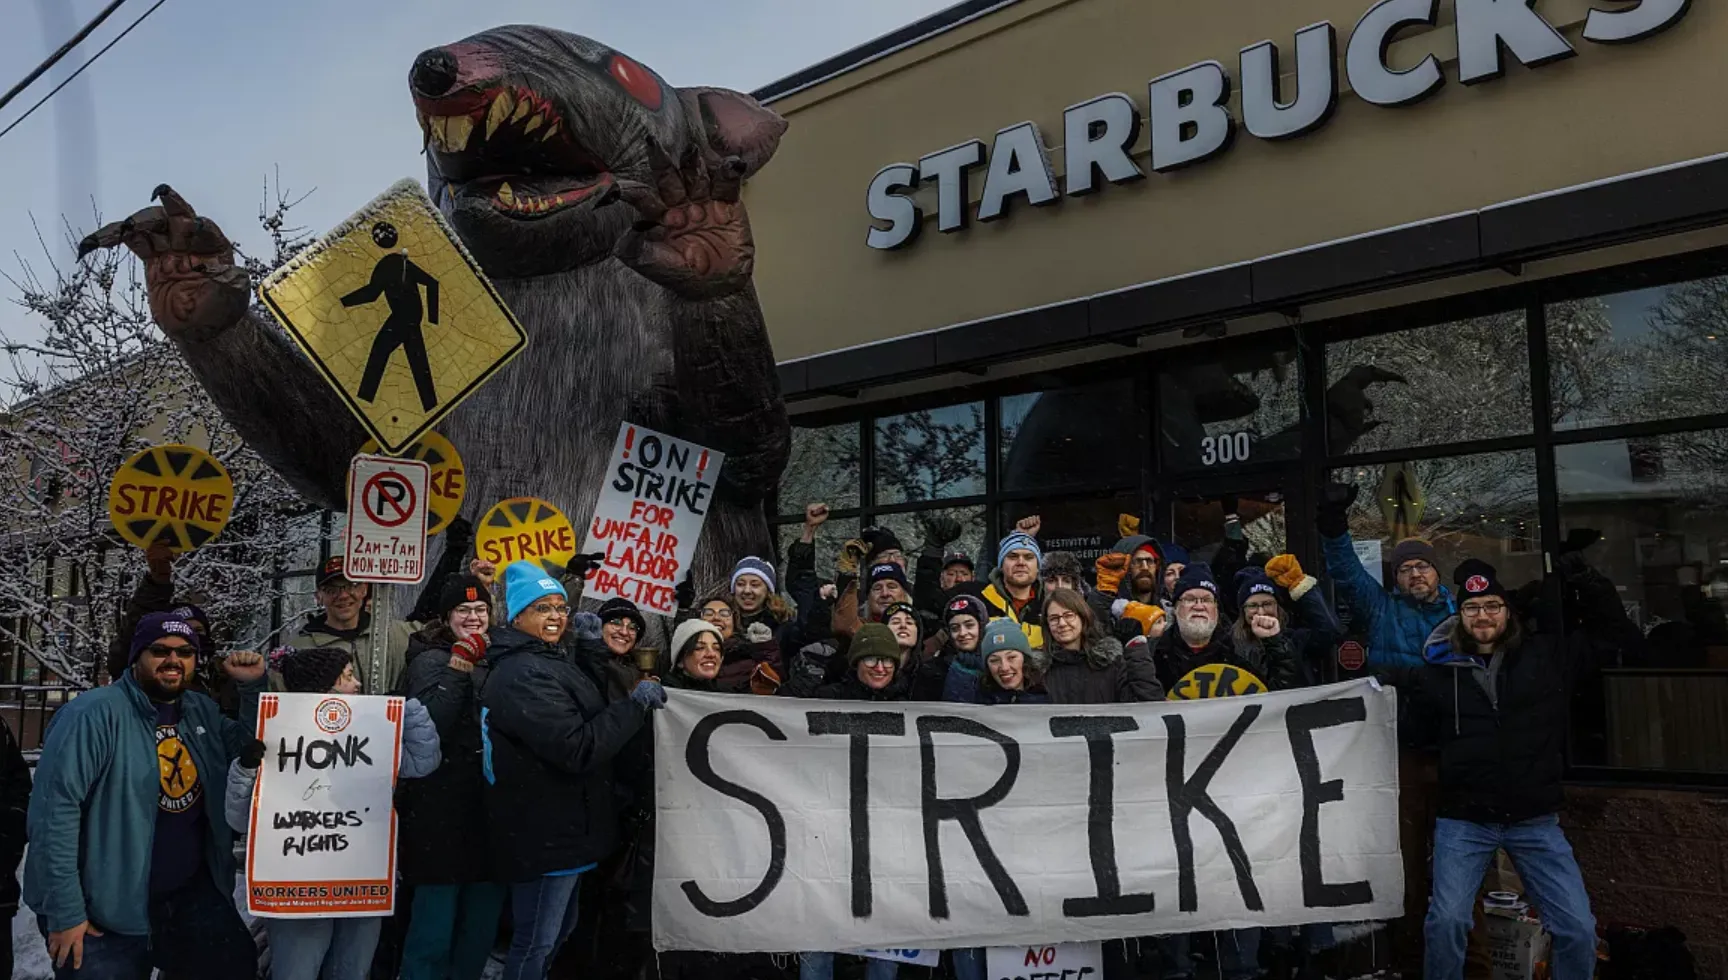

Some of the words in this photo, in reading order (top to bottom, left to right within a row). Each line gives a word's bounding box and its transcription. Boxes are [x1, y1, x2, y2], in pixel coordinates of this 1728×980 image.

[639, 435, 690, 472] ON
[1201, 432, 1250, 466] 300
[115, 483, 226, 523] STRIKE
[612, 462, 710, 515] STRIKE
[630, 501, 674, 529] FOR
[483, 526, 573, 564] STRIKE
[592, 516, 678, 557] UNFAIR
[604, 541, 679, 581] LABOR
[277, 734, 373, 774] HONK
[679, 695, 1373, 921] STRIKE
[283, 834, 349, 856] RIGHTS
[252, 886, 328, 897] WORKERS
[333, 885, 389, 896] UNITED
[1024, 945, 1056, 967] NO
